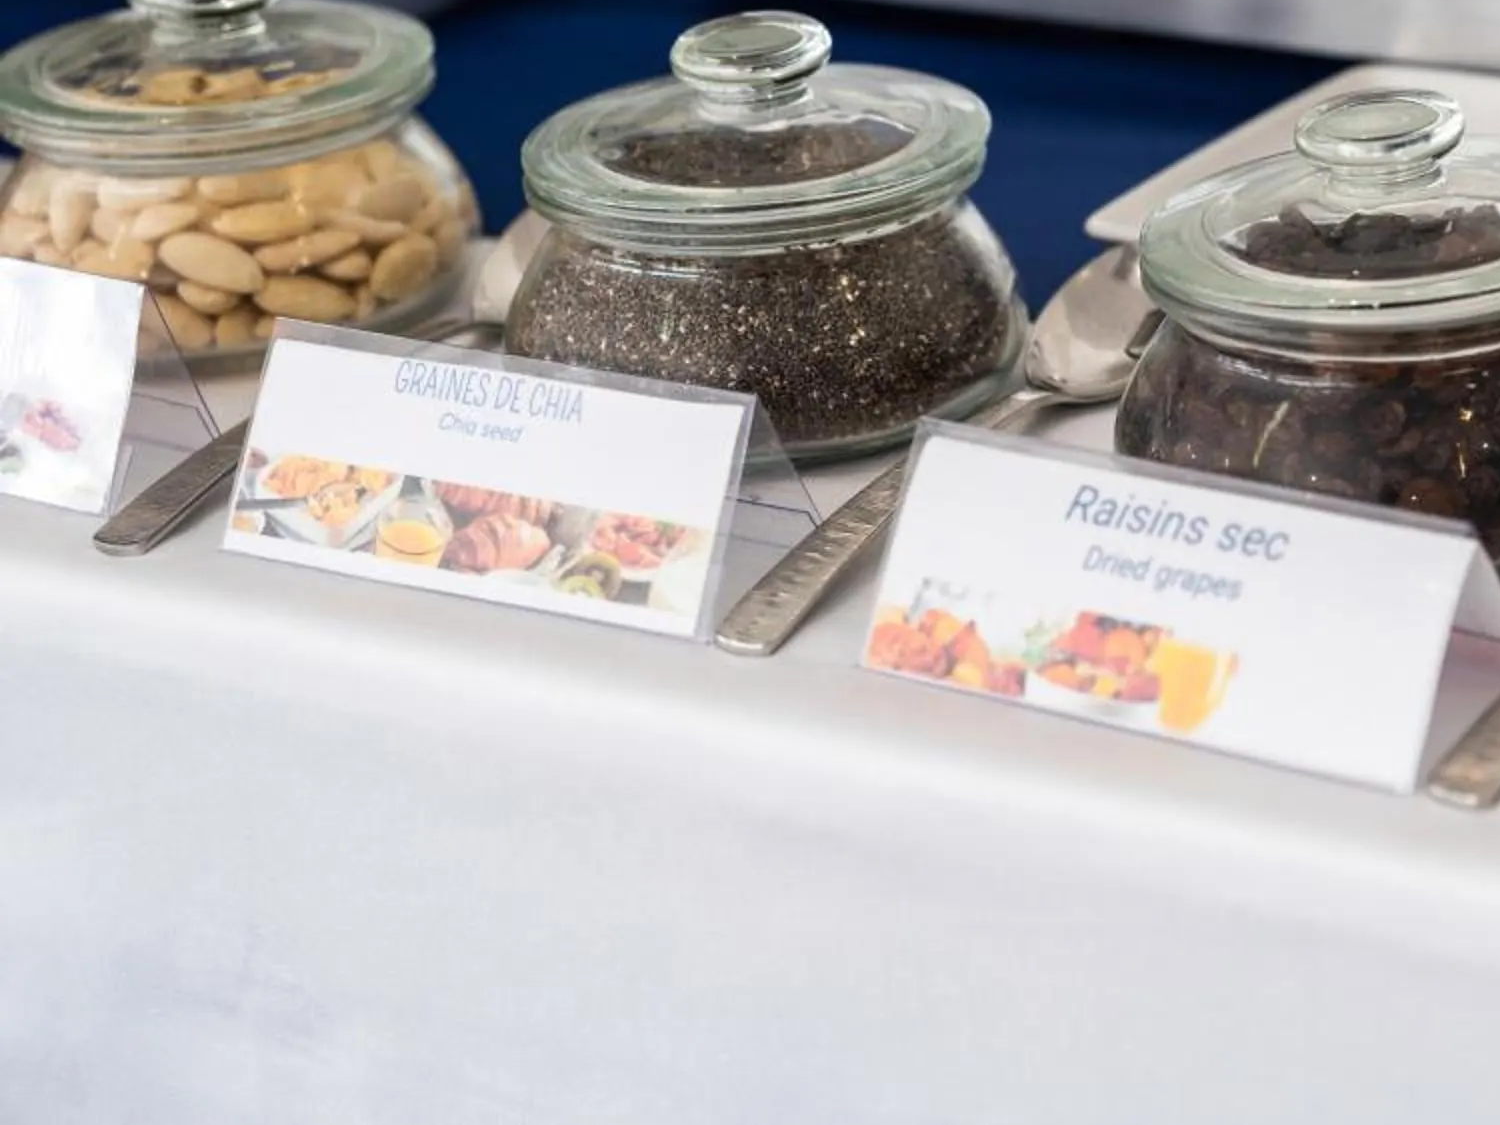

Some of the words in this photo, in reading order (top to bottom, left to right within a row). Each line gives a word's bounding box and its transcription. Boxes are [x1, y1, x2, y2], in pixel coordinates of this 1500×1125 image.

[394, 360, 491, 408] GRAINES
[493, 376, 526, 414] DE
[529, 382, 583, 422] CHIA
[437, 412, 478, 437] Chia
[480, 422, 524, 443] seed
[1065, 484, 1210, 545] Raisins
[1216, 522, 1291, 562] sec
[1082, 544, 1154, 582] Dried
[1154, 565, 1243, 600] grapes
